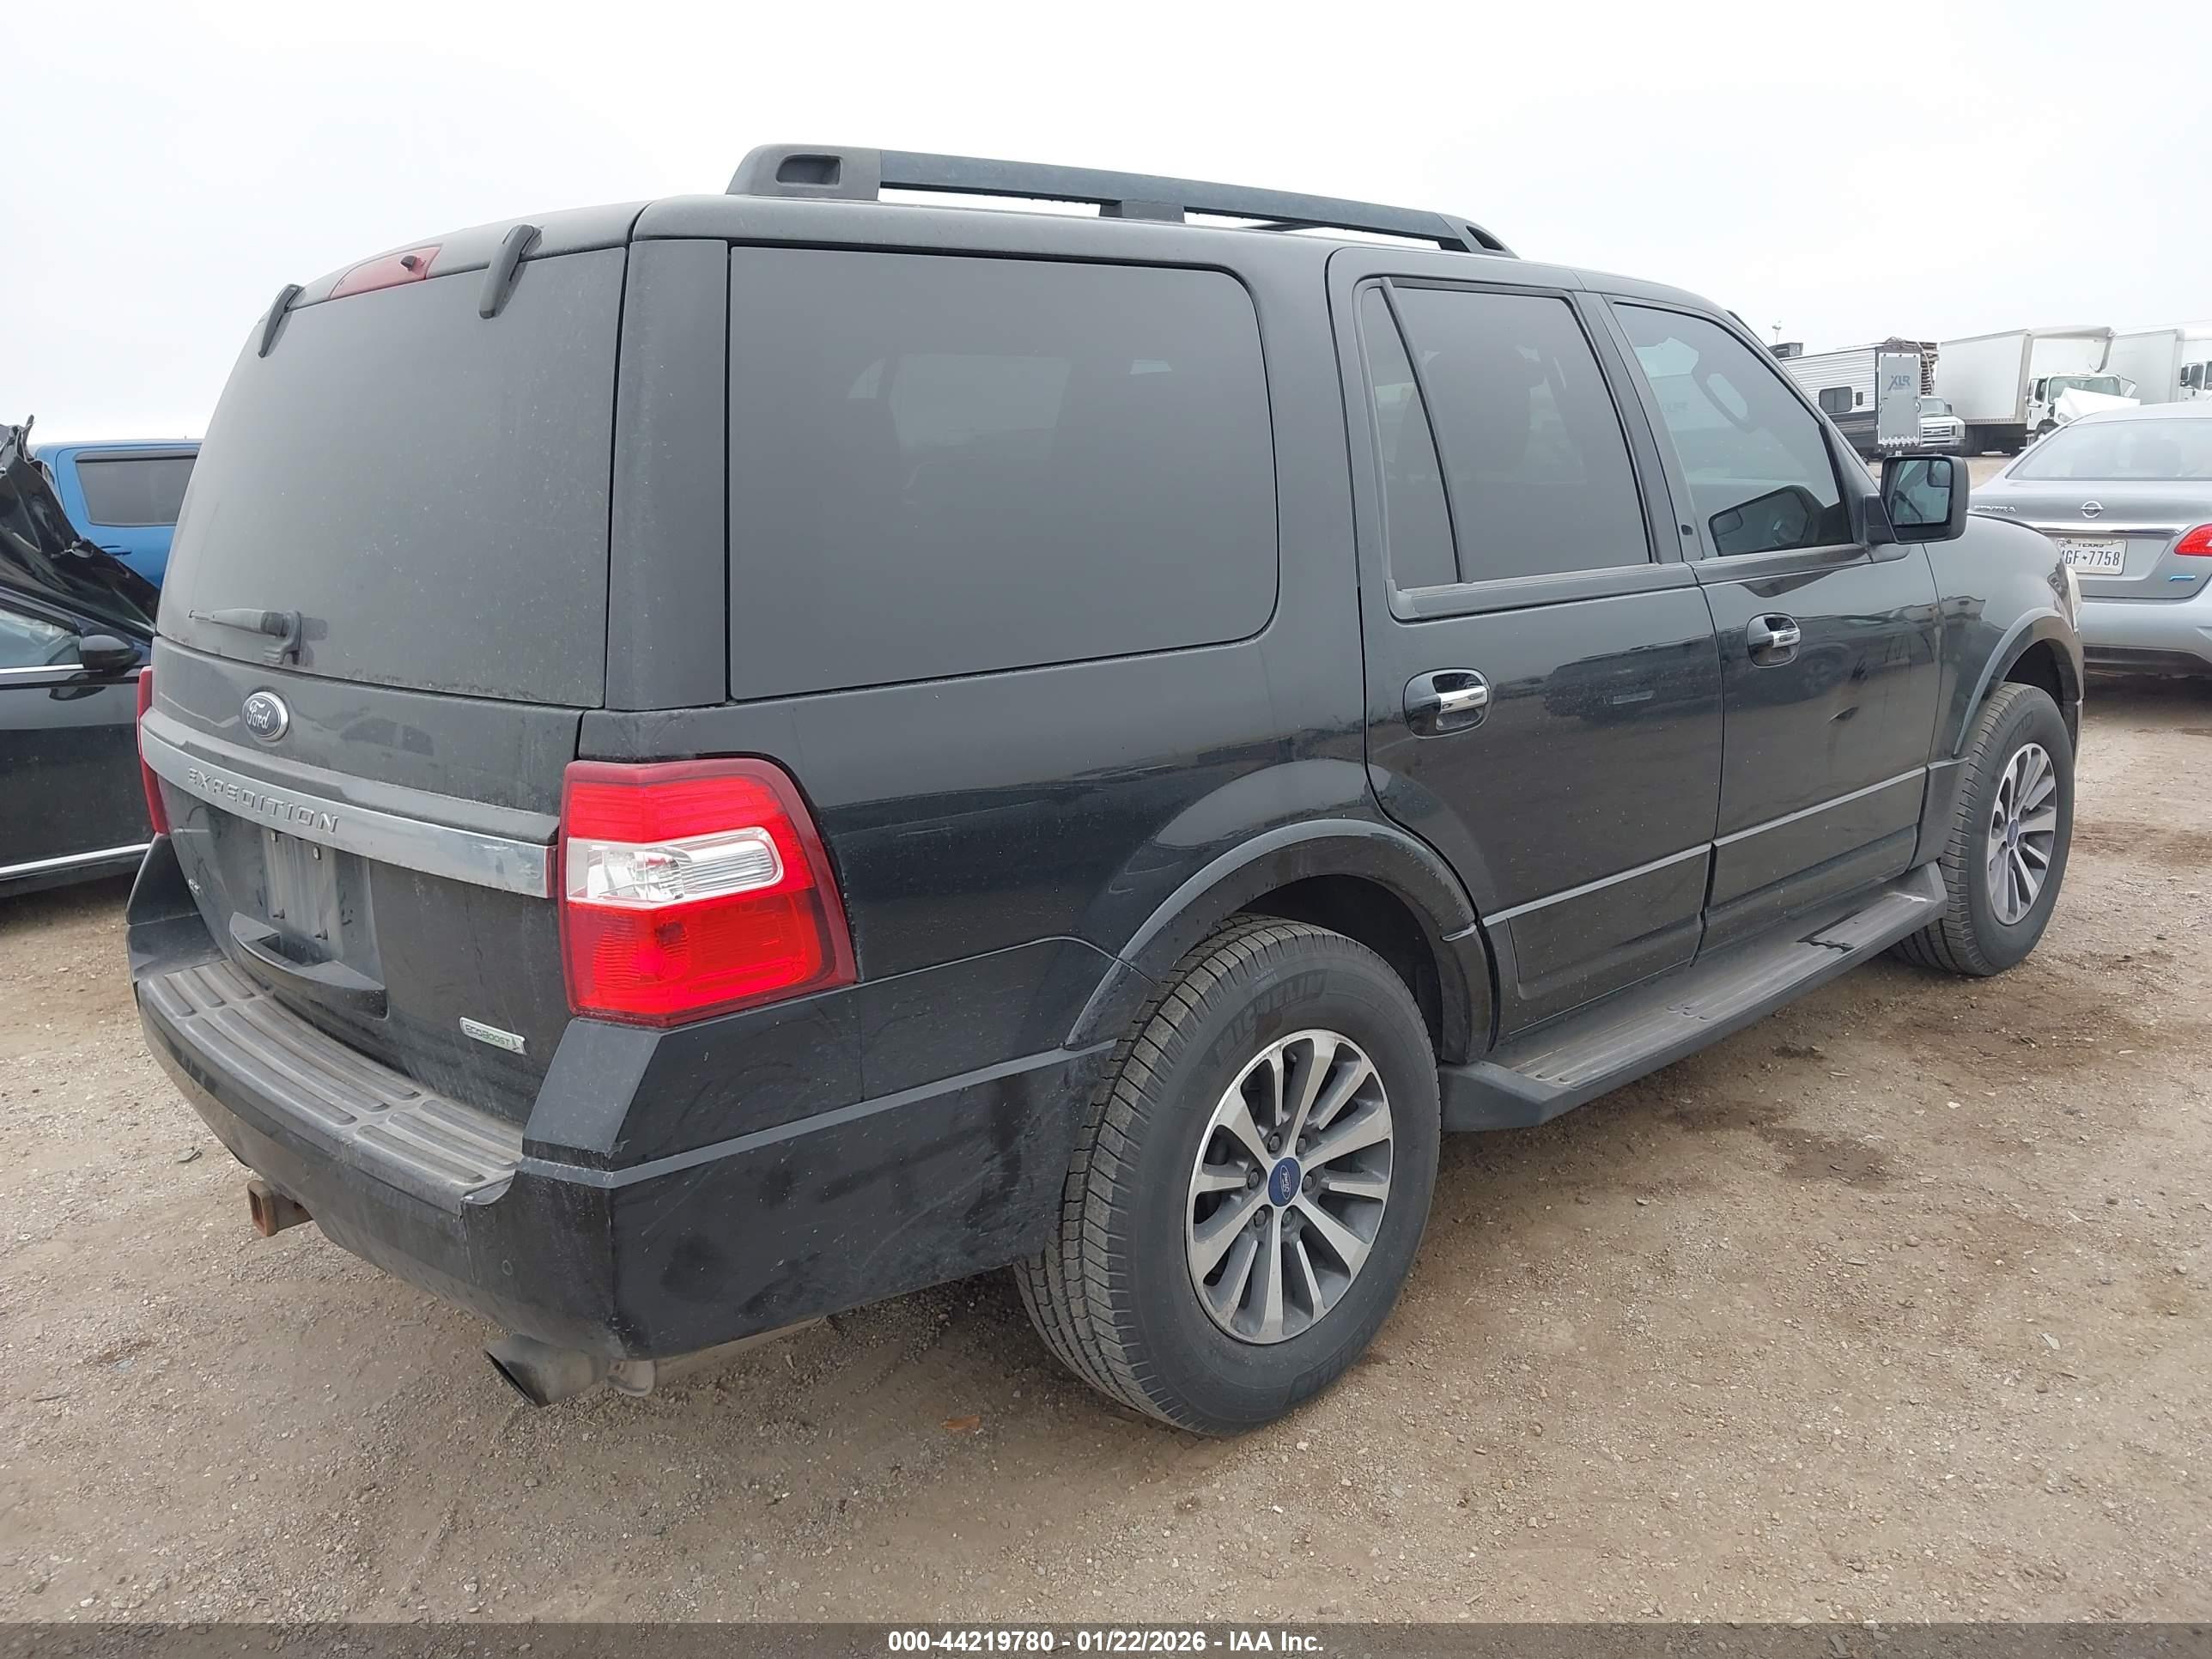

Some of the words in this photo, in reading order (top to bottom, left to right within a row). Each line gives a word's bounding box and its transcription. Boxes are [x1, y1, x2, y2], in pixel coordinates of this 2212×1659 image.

[1888, 375, 1911, 391] XLR
[246, 700, 271, 729] Ford
[187, 768, 340, 834] EXPEDITION
